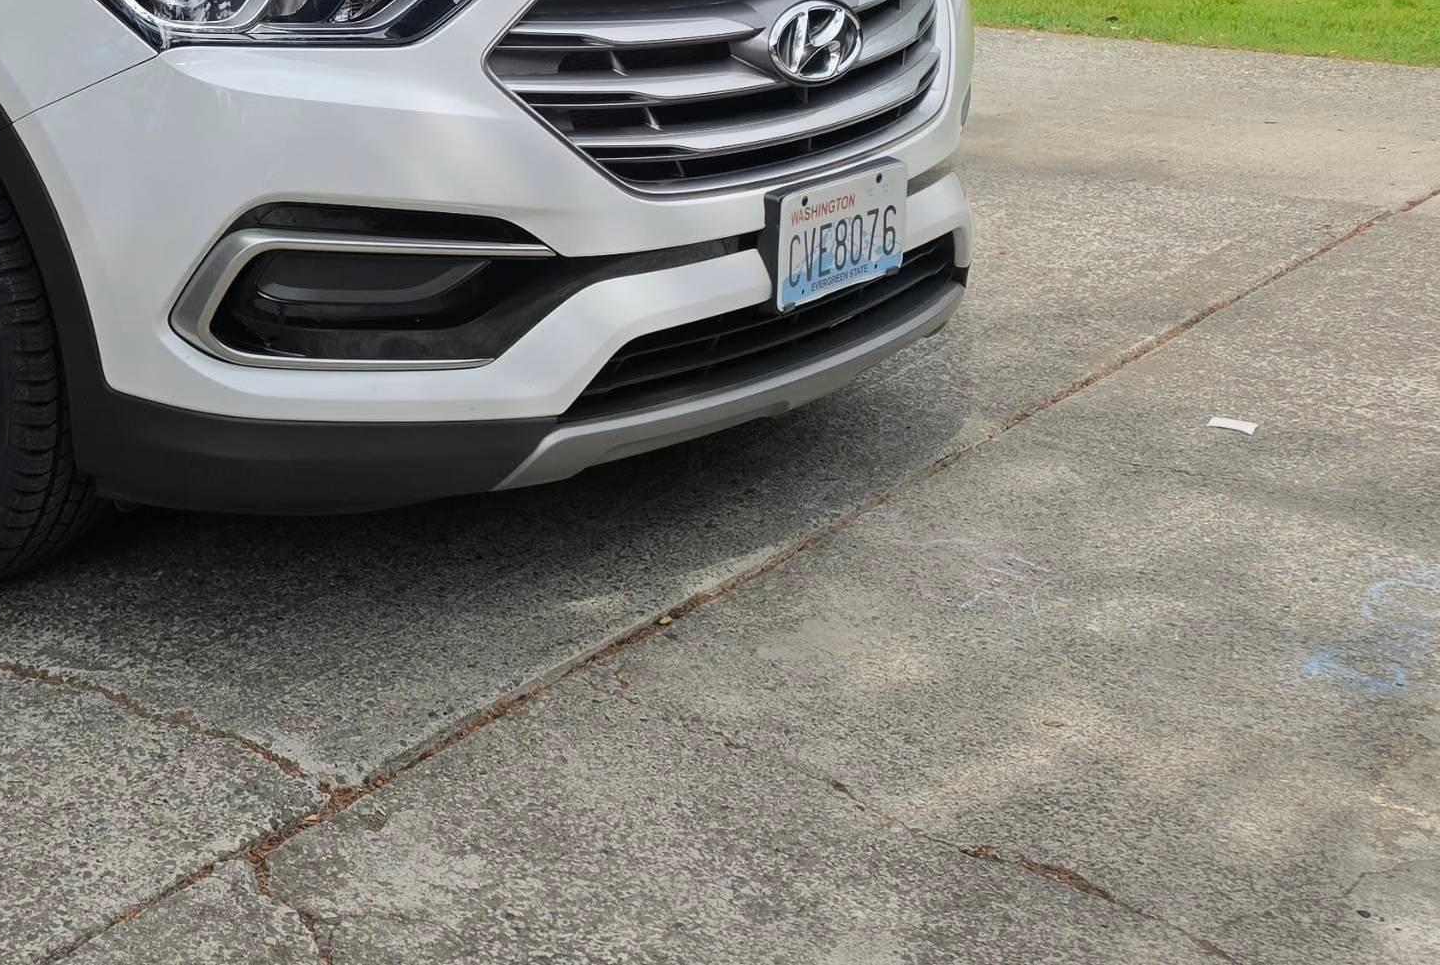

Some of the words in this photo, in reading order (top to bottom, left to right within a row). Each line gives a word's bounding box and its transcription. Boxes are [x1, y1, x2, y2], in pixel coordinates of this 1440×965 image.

[791, 194, 856, 225] WASHINGTON
[788, 204, 897, 287] CVE8076
[811, 270, 849, 292] EVERGREEN
[849, 264, 869, 278] STATE
